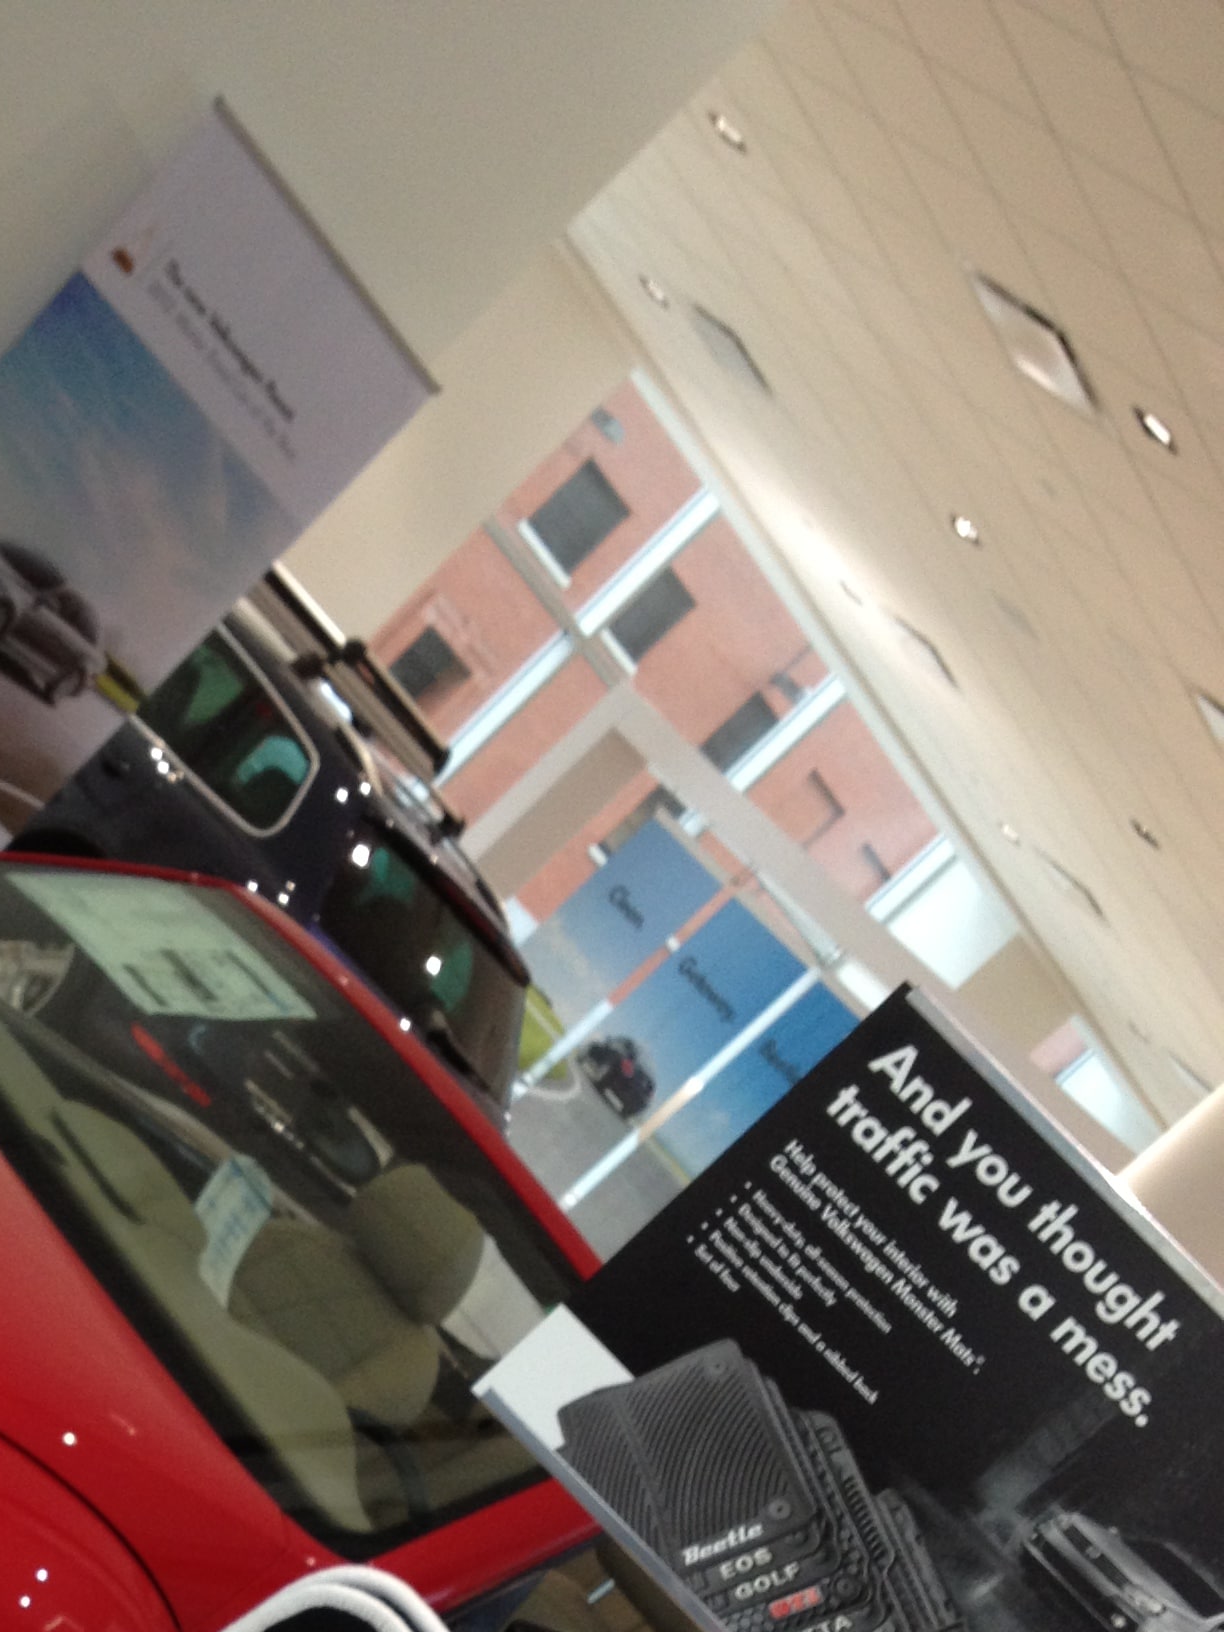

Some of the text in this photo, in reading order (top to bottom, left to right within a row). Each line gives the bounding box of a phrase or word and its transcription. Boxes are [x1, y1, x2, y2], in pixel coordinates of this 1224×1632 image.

[783, 1138, 960, 1318] Help protect your interior with
[868, 1038, 1184, 1357] And you thought
[736, 1202, 782, 1250] Designed
[795, 1264, 838, 1307] perfectly
[758, 1254, 804, 1300] underside
[768, 1153, 824, 1210] Genuine
[818, 1203, 896, 1286] Volkswagen
[890, 1278, 945, 1334] Monster
[824, 1080, 1157, 1428] traffic was a mess.
[844, 1286, 893, 1334] protection
[681, 1522, 764, 1566] Beetle
[718, 1546, 773, 1580] EOS
[732, 1562, 800, 1600] GOLF
